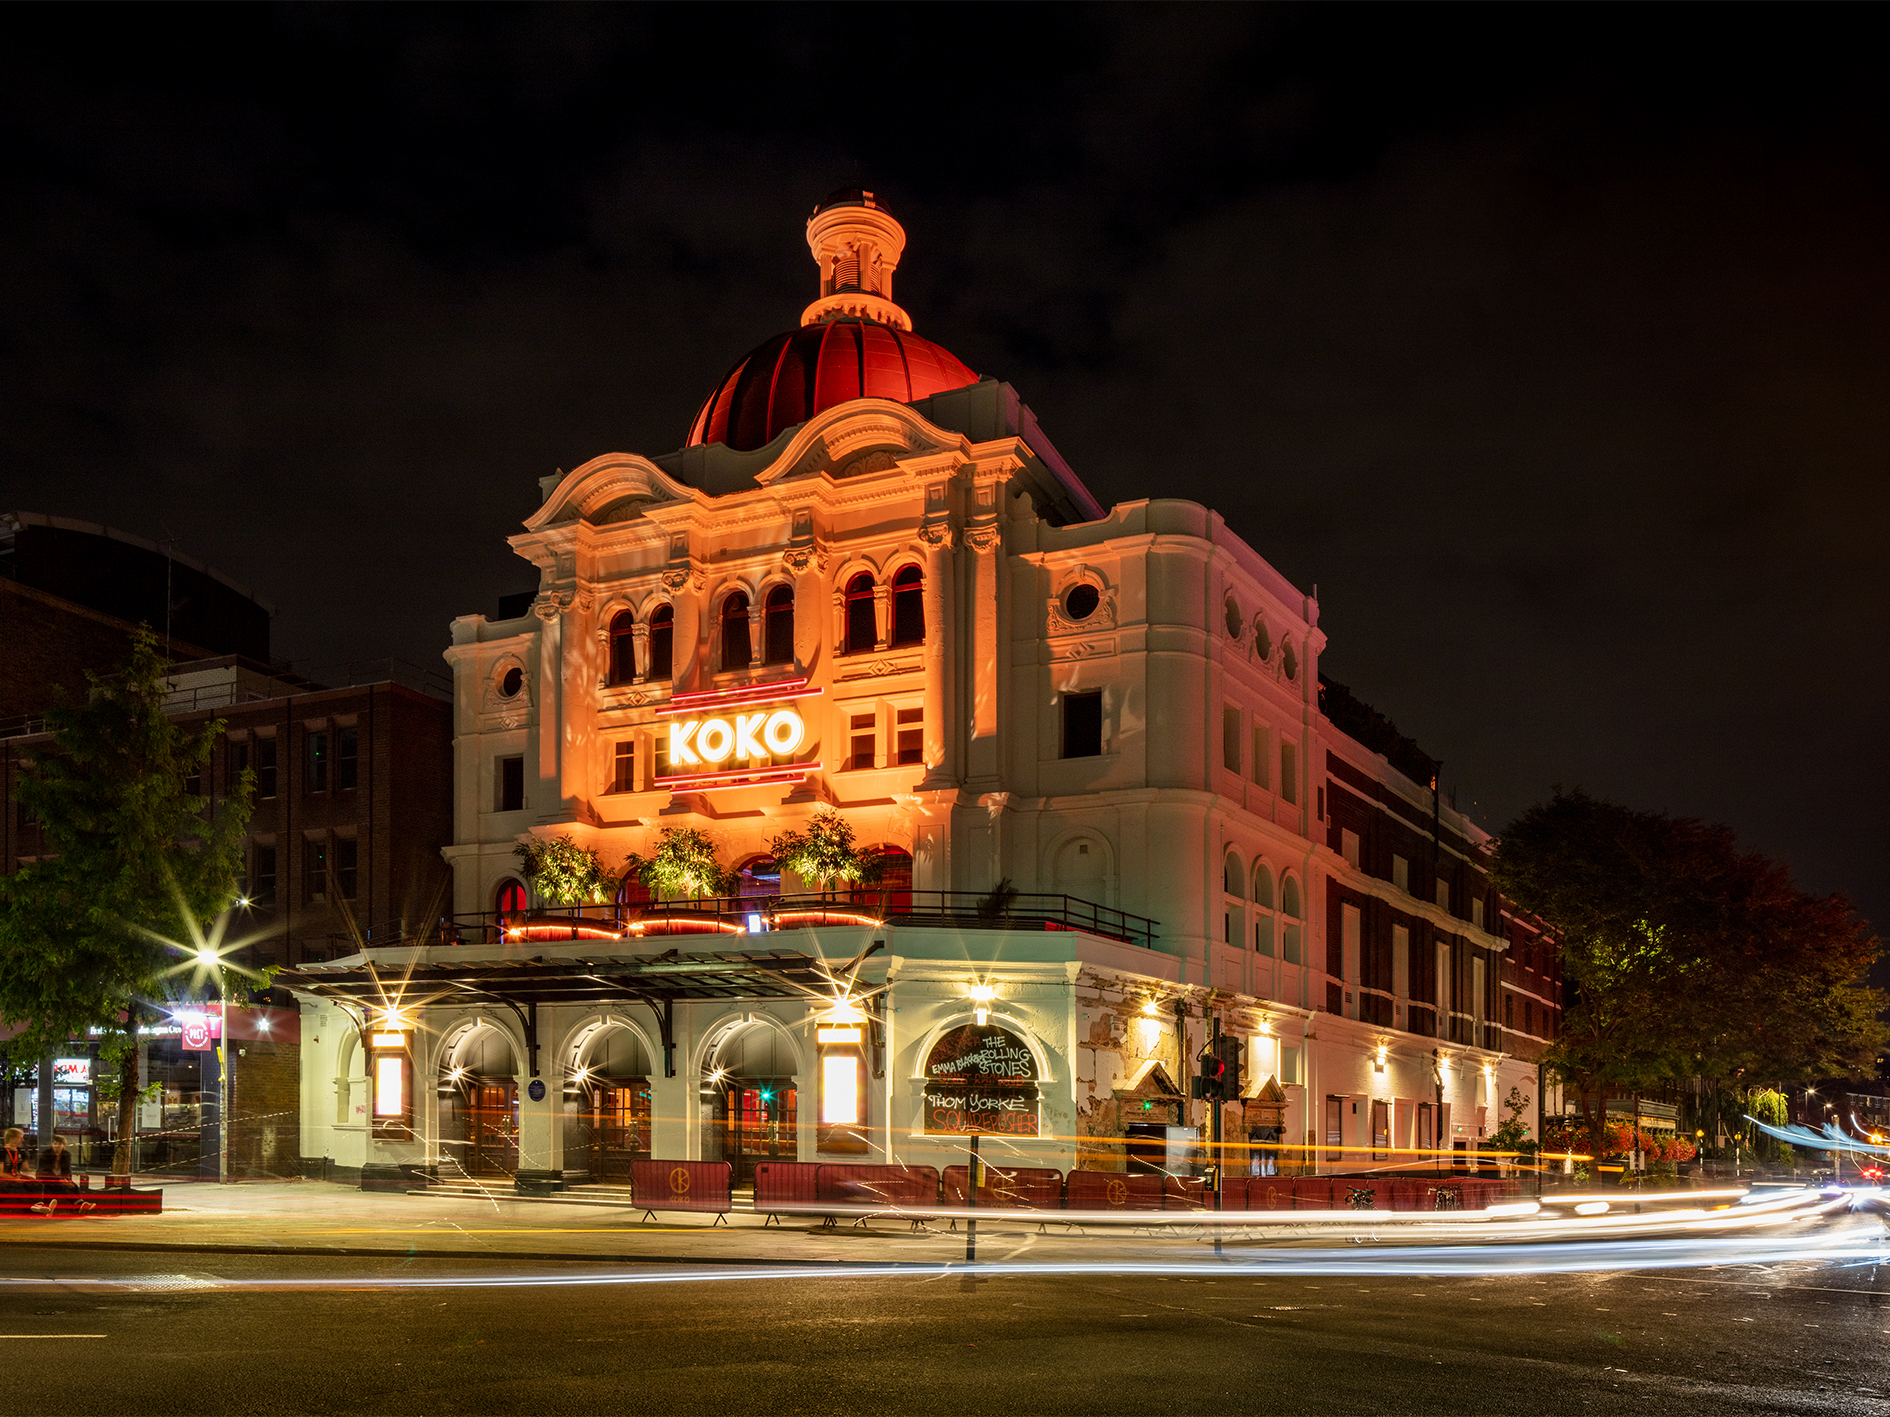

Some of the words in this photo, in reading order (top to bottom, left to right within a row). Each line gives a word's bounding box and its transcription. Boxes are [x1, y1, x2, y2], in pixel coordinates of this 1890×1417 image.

[670, 710, 804, 766] KOKO
[982, 1036, 1006, 1048] THE
[980, 1047, 1032, 1061] ROLLING
[932, 1061, 957, 1074] EMMA
[979, 1060, 1032, 1078] STONES
[927, 1092, 966, 1109] THOM
[969, 1093, 1029, 1113] YORKE
[932, 1109, 1038, 1133] SQUAREPUSHER
